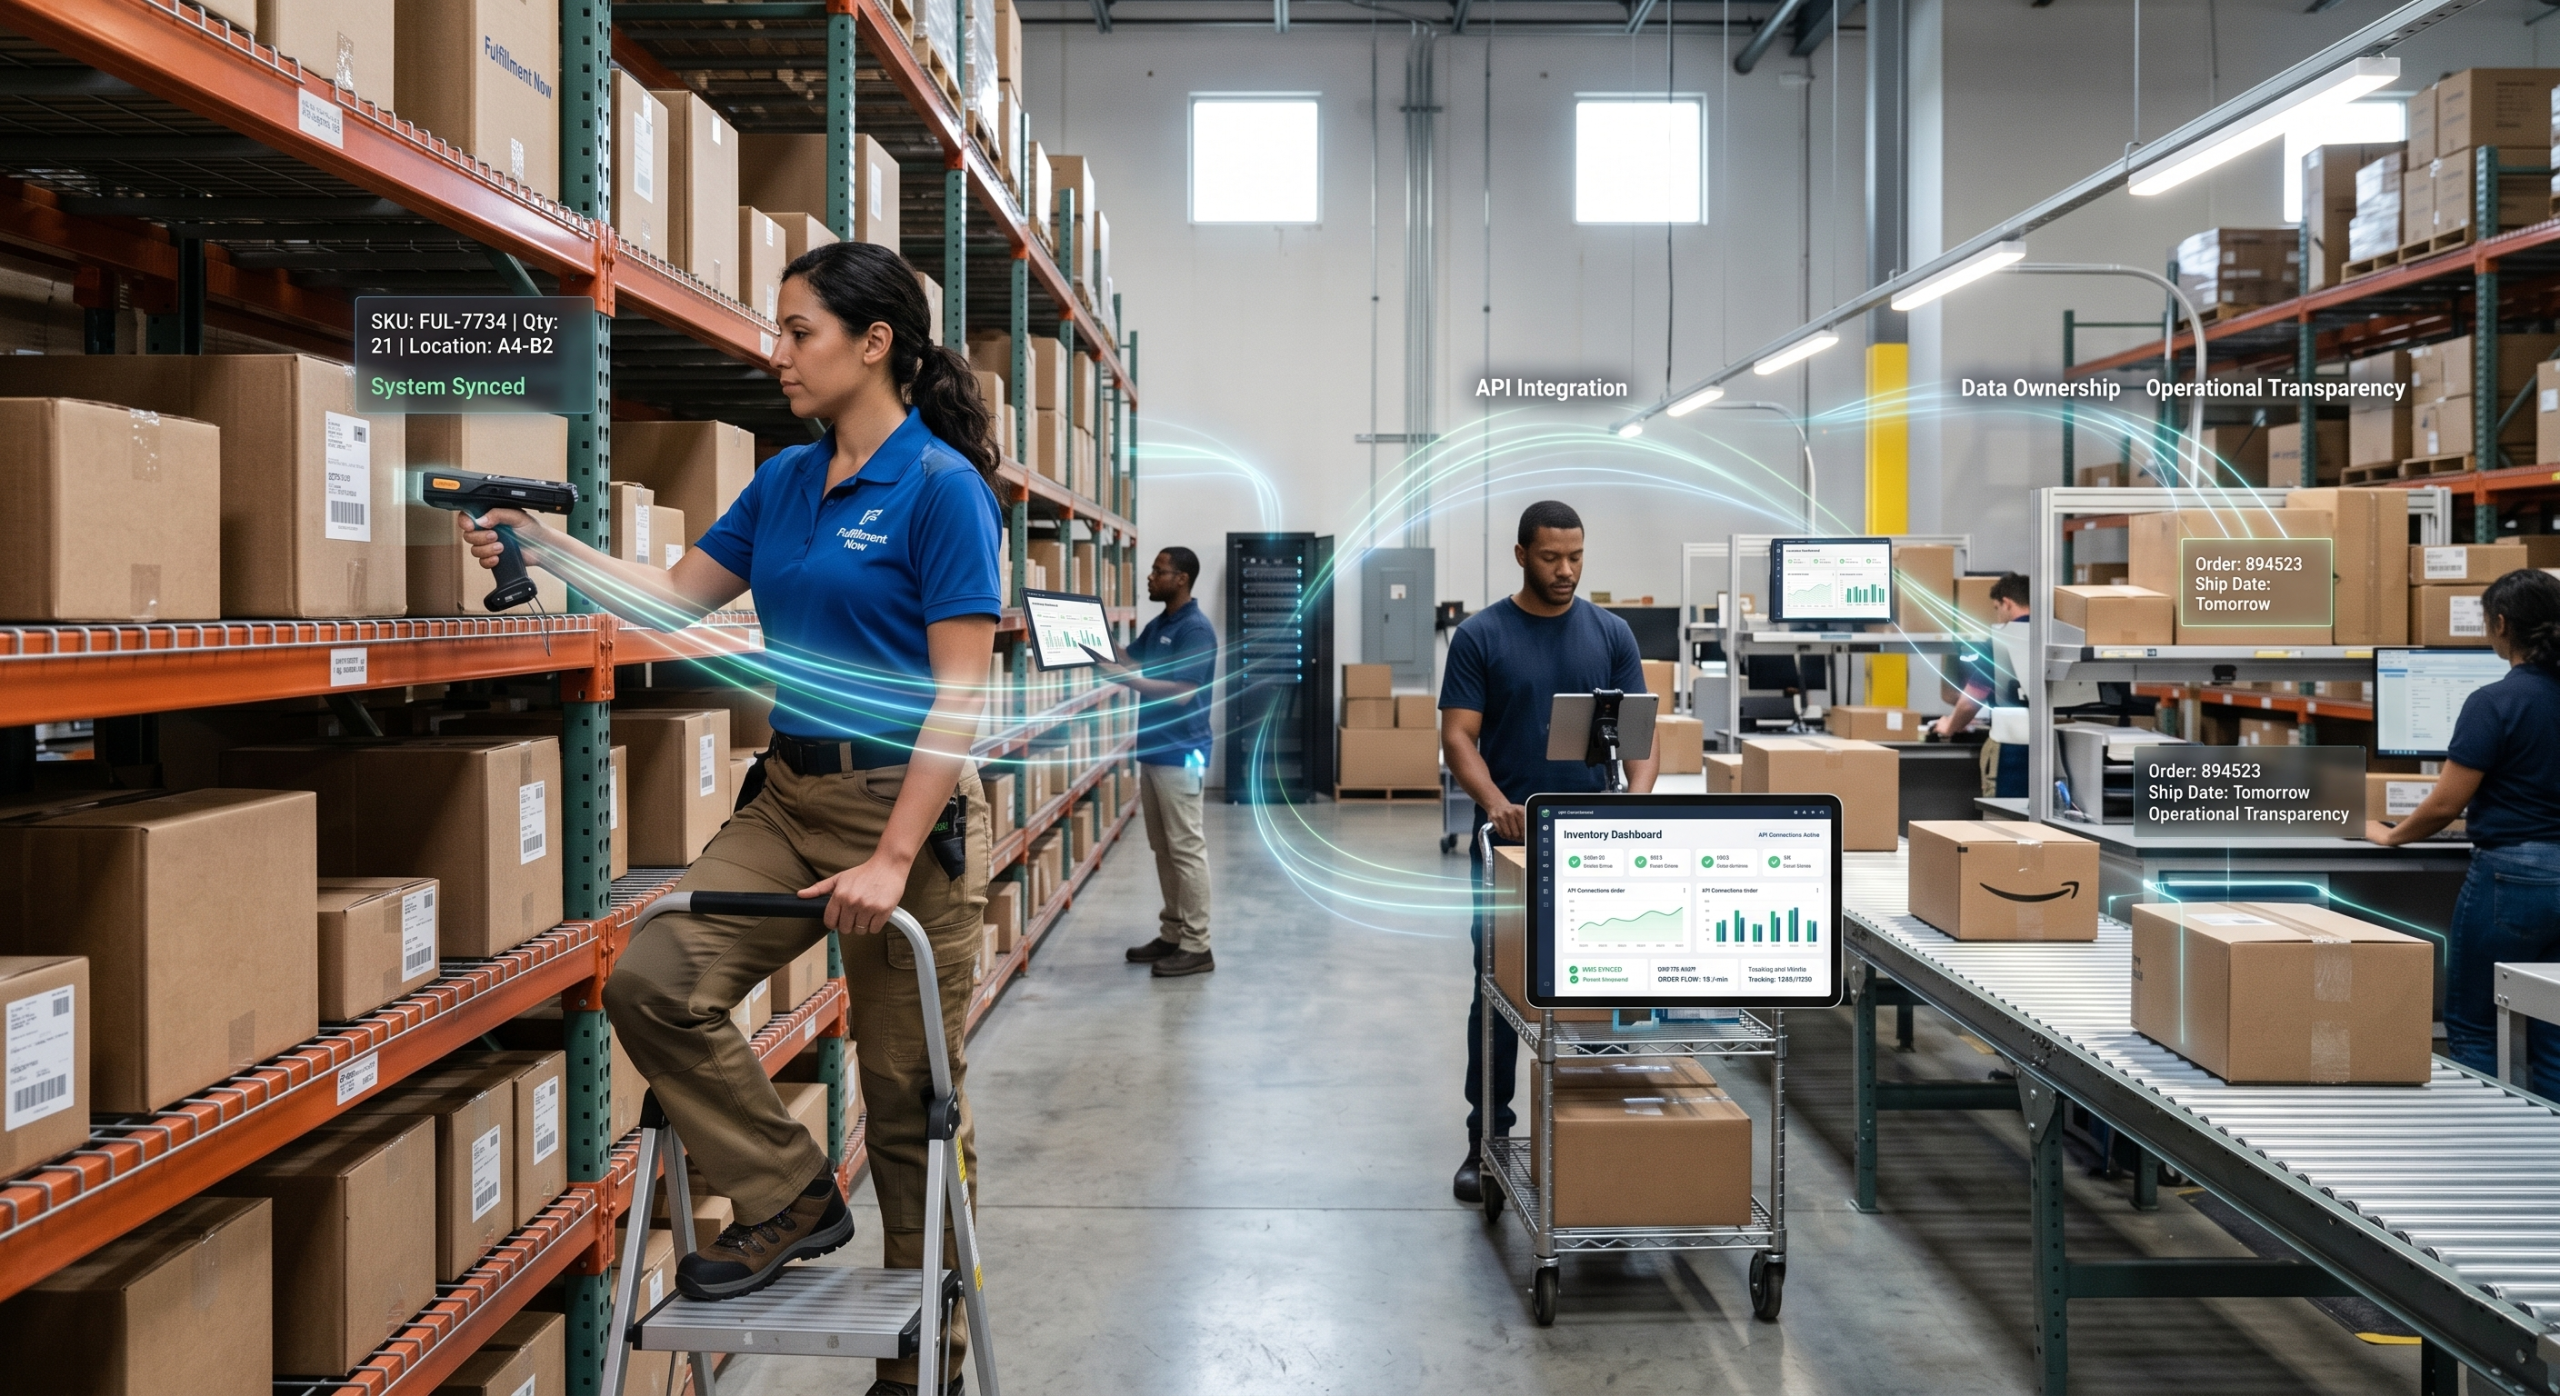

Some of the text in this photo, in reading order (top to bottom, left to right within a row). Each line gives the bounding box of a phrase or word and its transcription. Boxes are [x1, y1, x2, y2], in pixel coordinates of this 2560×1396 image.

[485, 35, 552, 99] Fulfillment Now
[843, 539, 868, 551] Now
[1563, 829, 1663, 841] Inventory Dashboard
